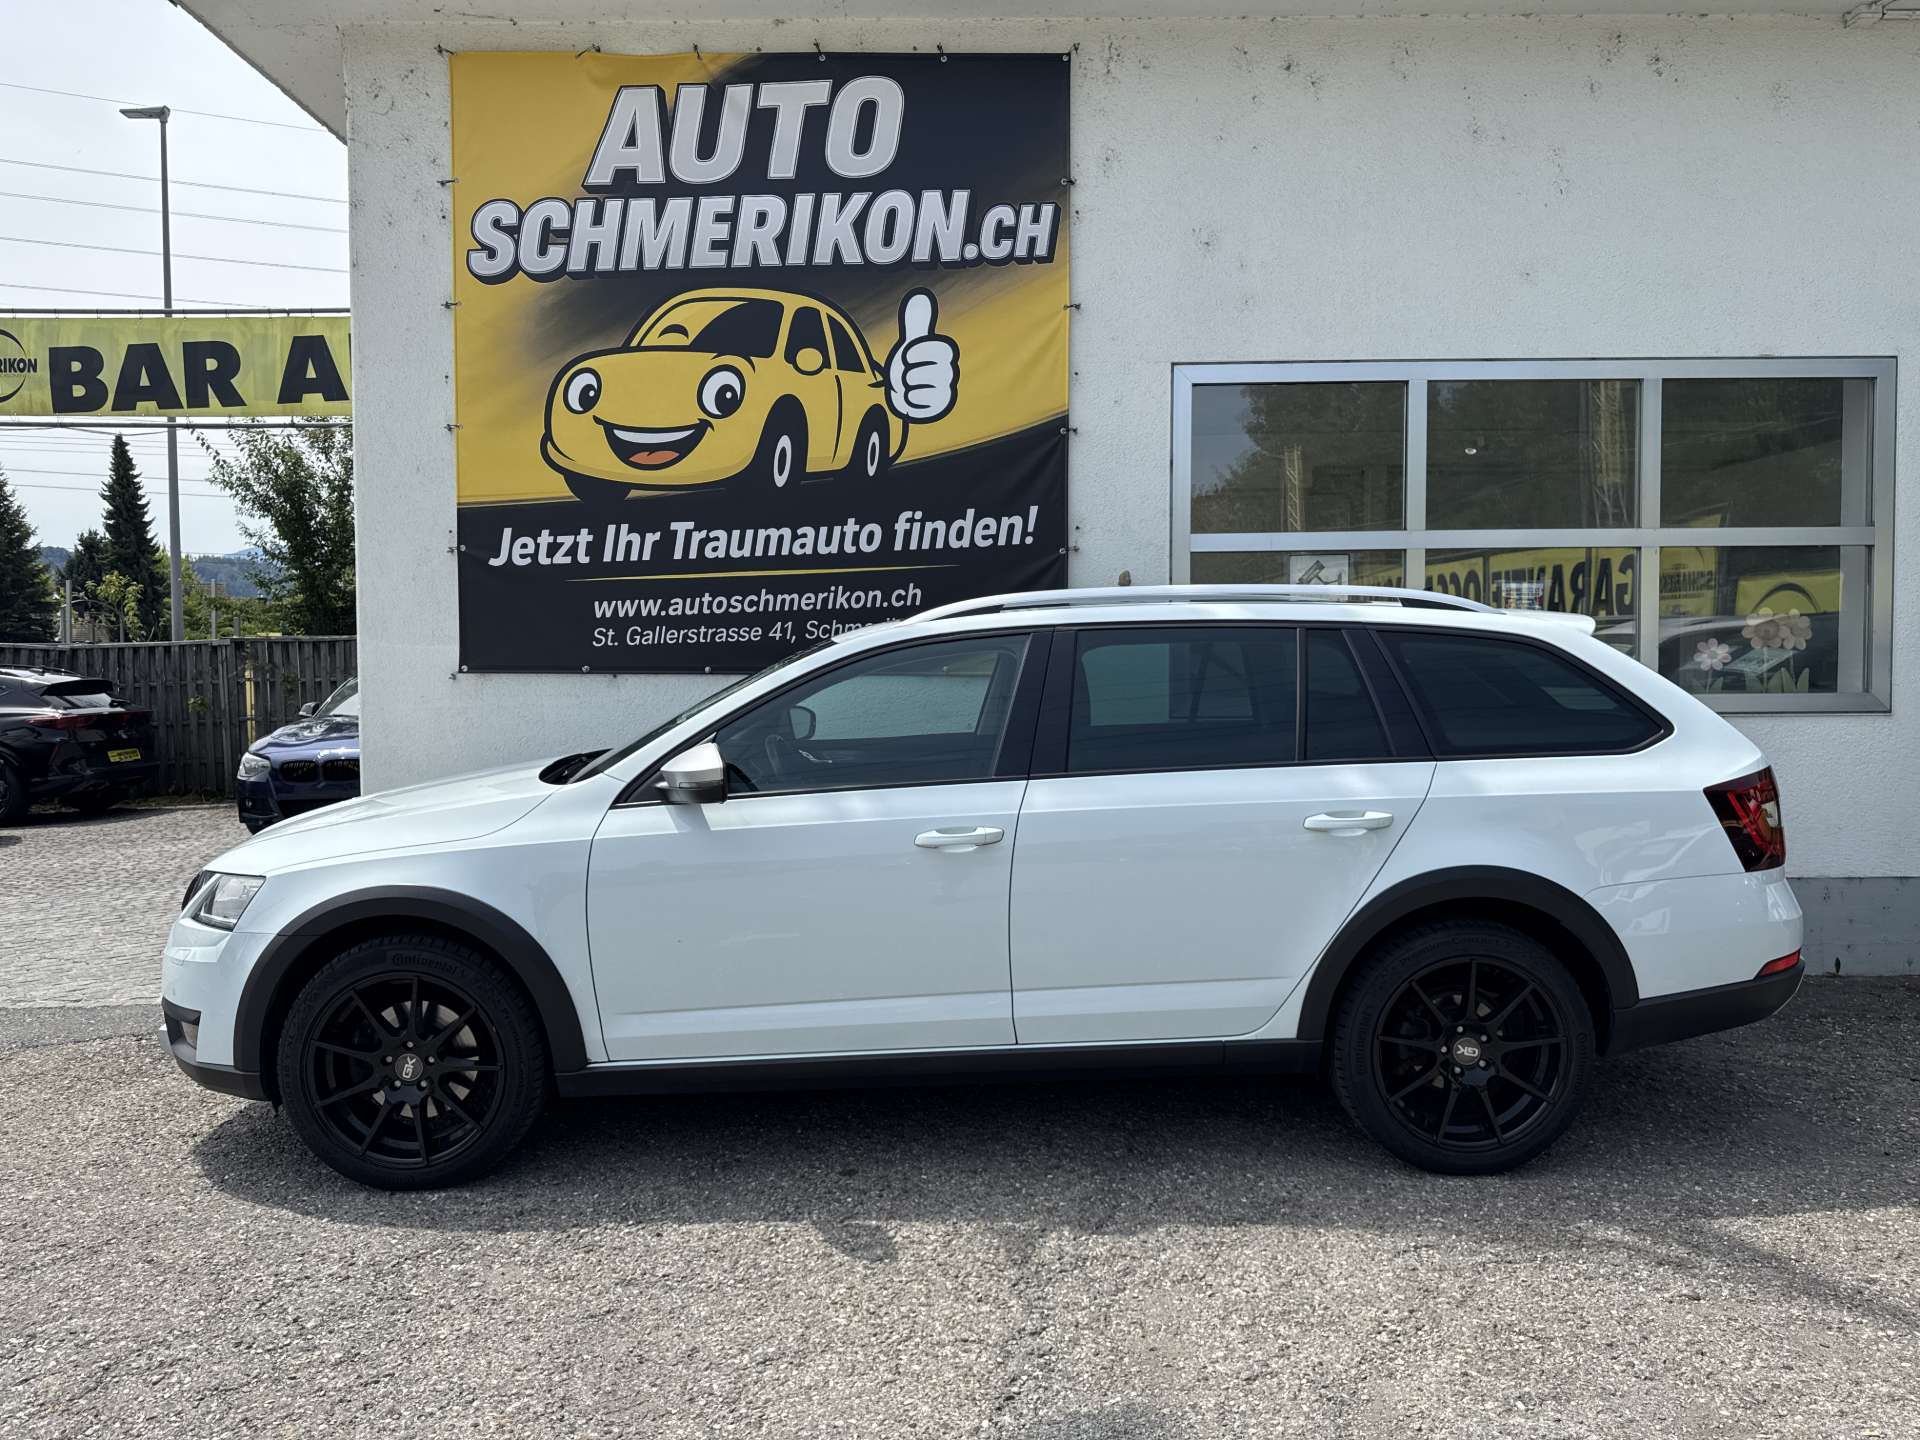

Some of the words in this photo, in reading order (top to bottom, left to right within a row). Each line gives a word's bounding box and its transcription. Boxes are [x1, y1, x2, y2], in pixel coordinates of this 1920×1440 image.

[582, 75, 906, 191] AUTO
[467, 188, 1060, 280] SCHMERIKON.CH
[49, 341, 247, 414] BAR
[277, 333, 352, 405] A
[488, 527, 593, 568] Jetzt
[603, 524, 657, 563] Ihr
[669, 517, 883, 560] Traumauto
[893, 505, 1040, 552] finden!
[593, 583, 923, 620] www.autoschmerikon.ch
[592, 627, 619, 647] St.
[626, 620, 762, 647] Gallerstrasse
[768, 620, 798, 644] 41,
[391, 952, 459, 976] Continental
